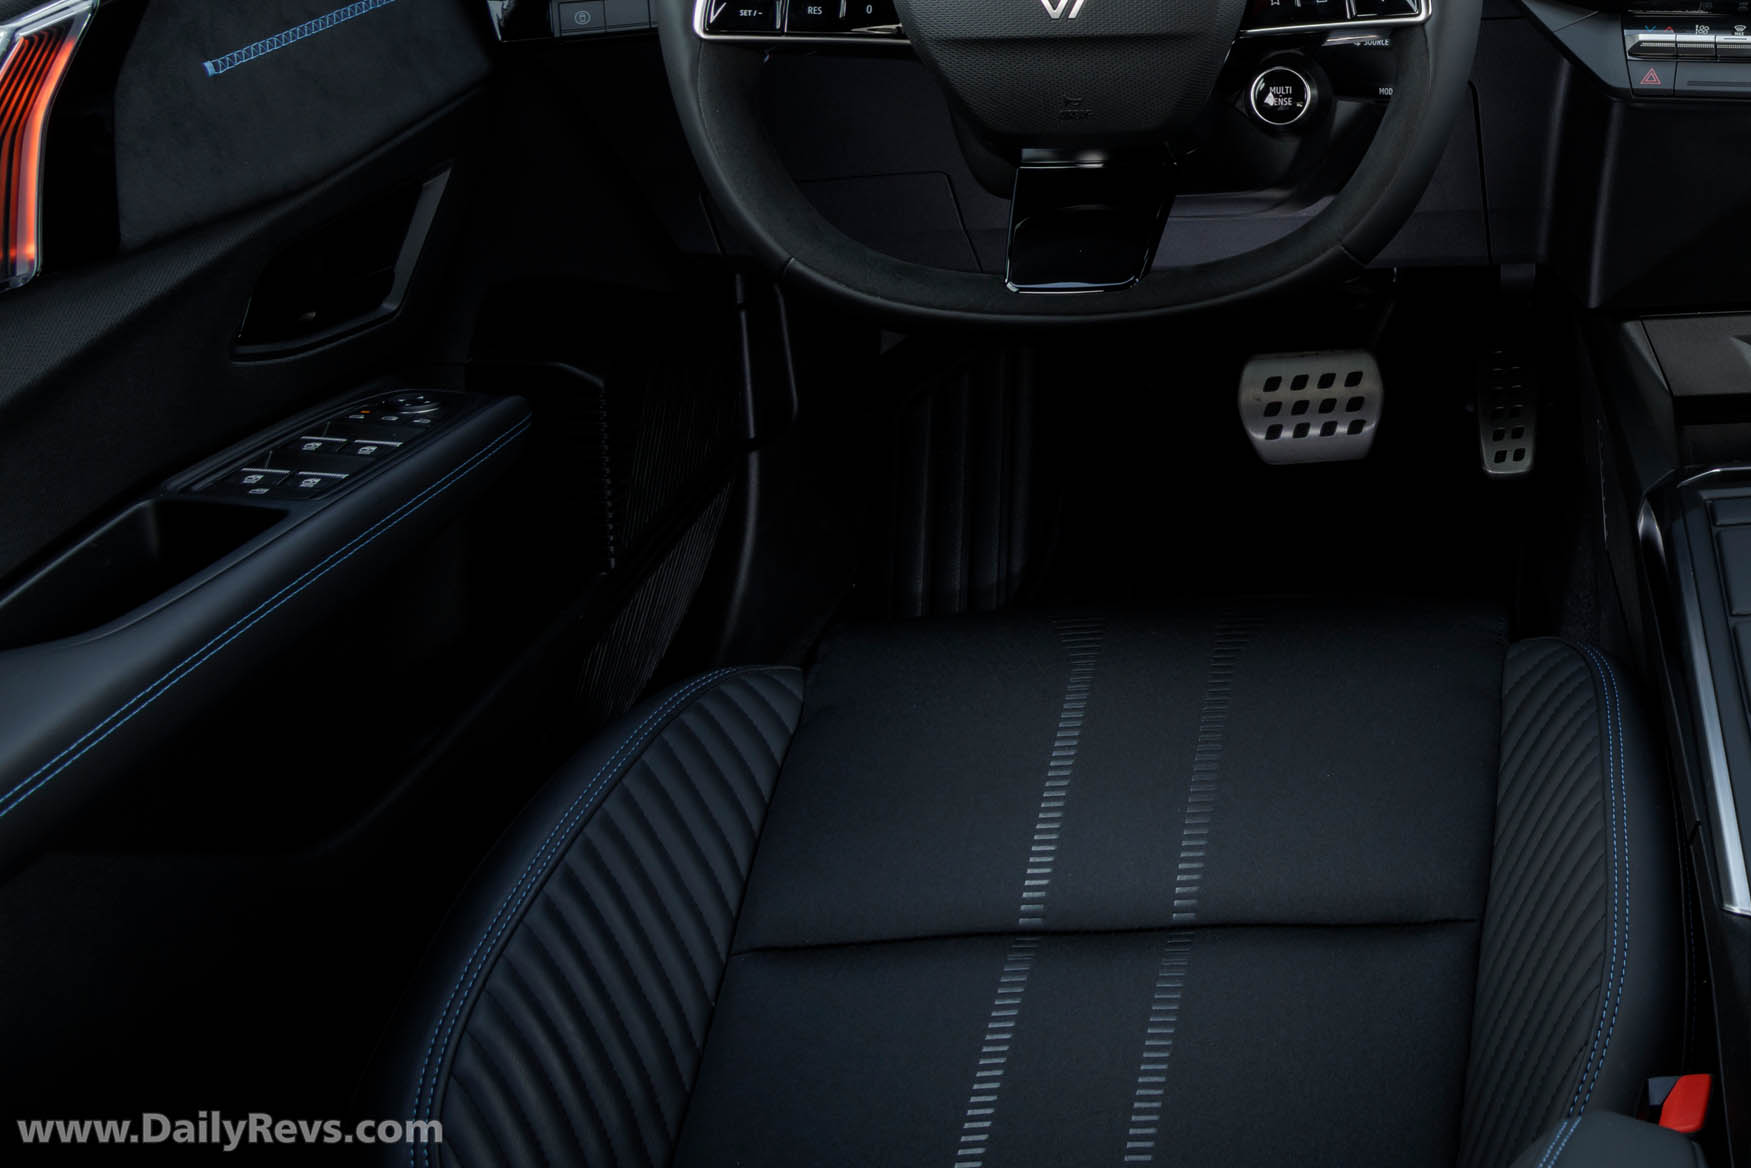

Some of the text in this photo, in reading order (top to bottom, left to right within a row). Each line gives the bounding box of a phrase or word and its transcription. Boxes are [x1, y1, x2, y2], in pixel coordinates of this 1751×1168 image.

[807, 6, 823, 15] RES
[1269, 86, 1293, 95] MULTI
[1270, 97, 1293, 106] ENSE
